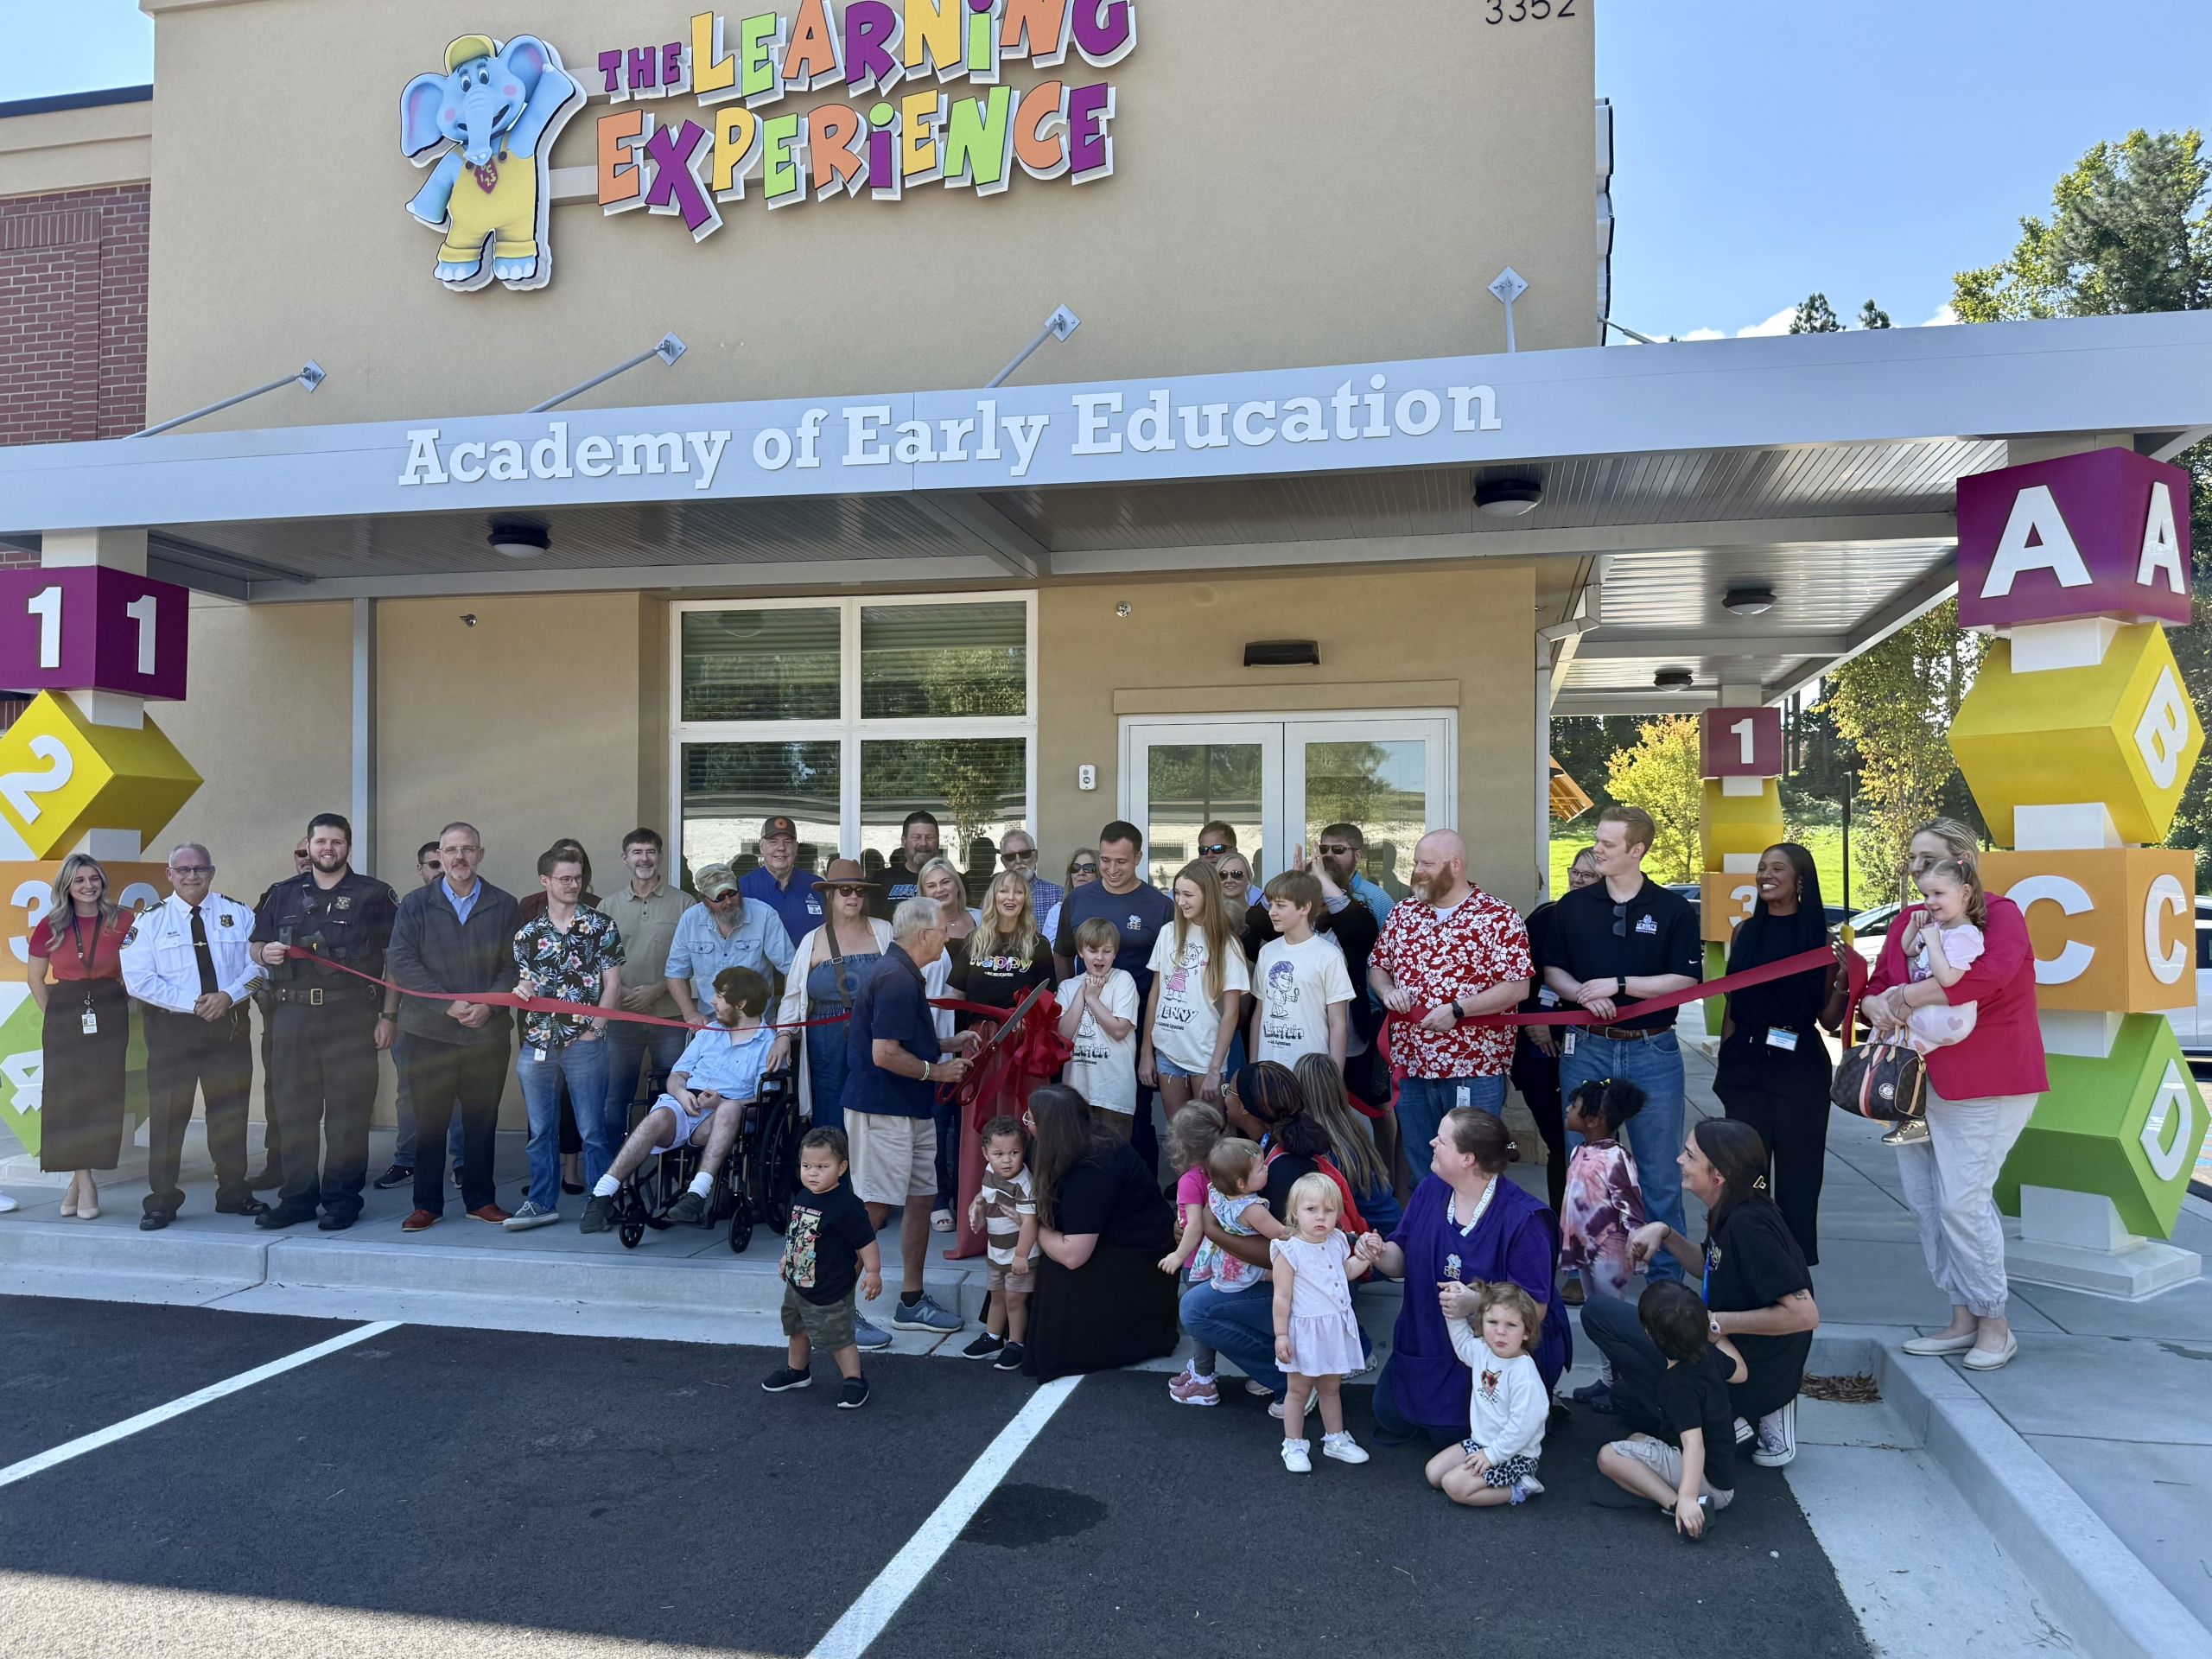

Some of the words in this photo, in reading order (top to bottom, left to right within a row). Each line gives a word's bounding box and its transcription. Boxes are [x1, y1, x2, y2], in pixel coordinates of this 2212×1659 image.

[598, 41, 684, 93] THE
[398, 421, 732, 490] Academy
[753, 408, 829, 471] of
[842, 399, 1050, 477] Early
[1071, 374, 1502, 455] Education
[1980, 485, 2094, 599] A
[2136, 481, 2186, 594] A
[29, 587, 62, 668] 1
[127, 594, 157, 675] 1
[0, 734, 73, 825] 2
[1731, 718, 1754, 764] 1
[2133, 664, 2189, 790] B
[9, 880, 53, 963] 3
[2004, 875, 2096, 984] C
[2145, 874, 2188, 984] C
[2139, 1058, 2192, 1182] D
